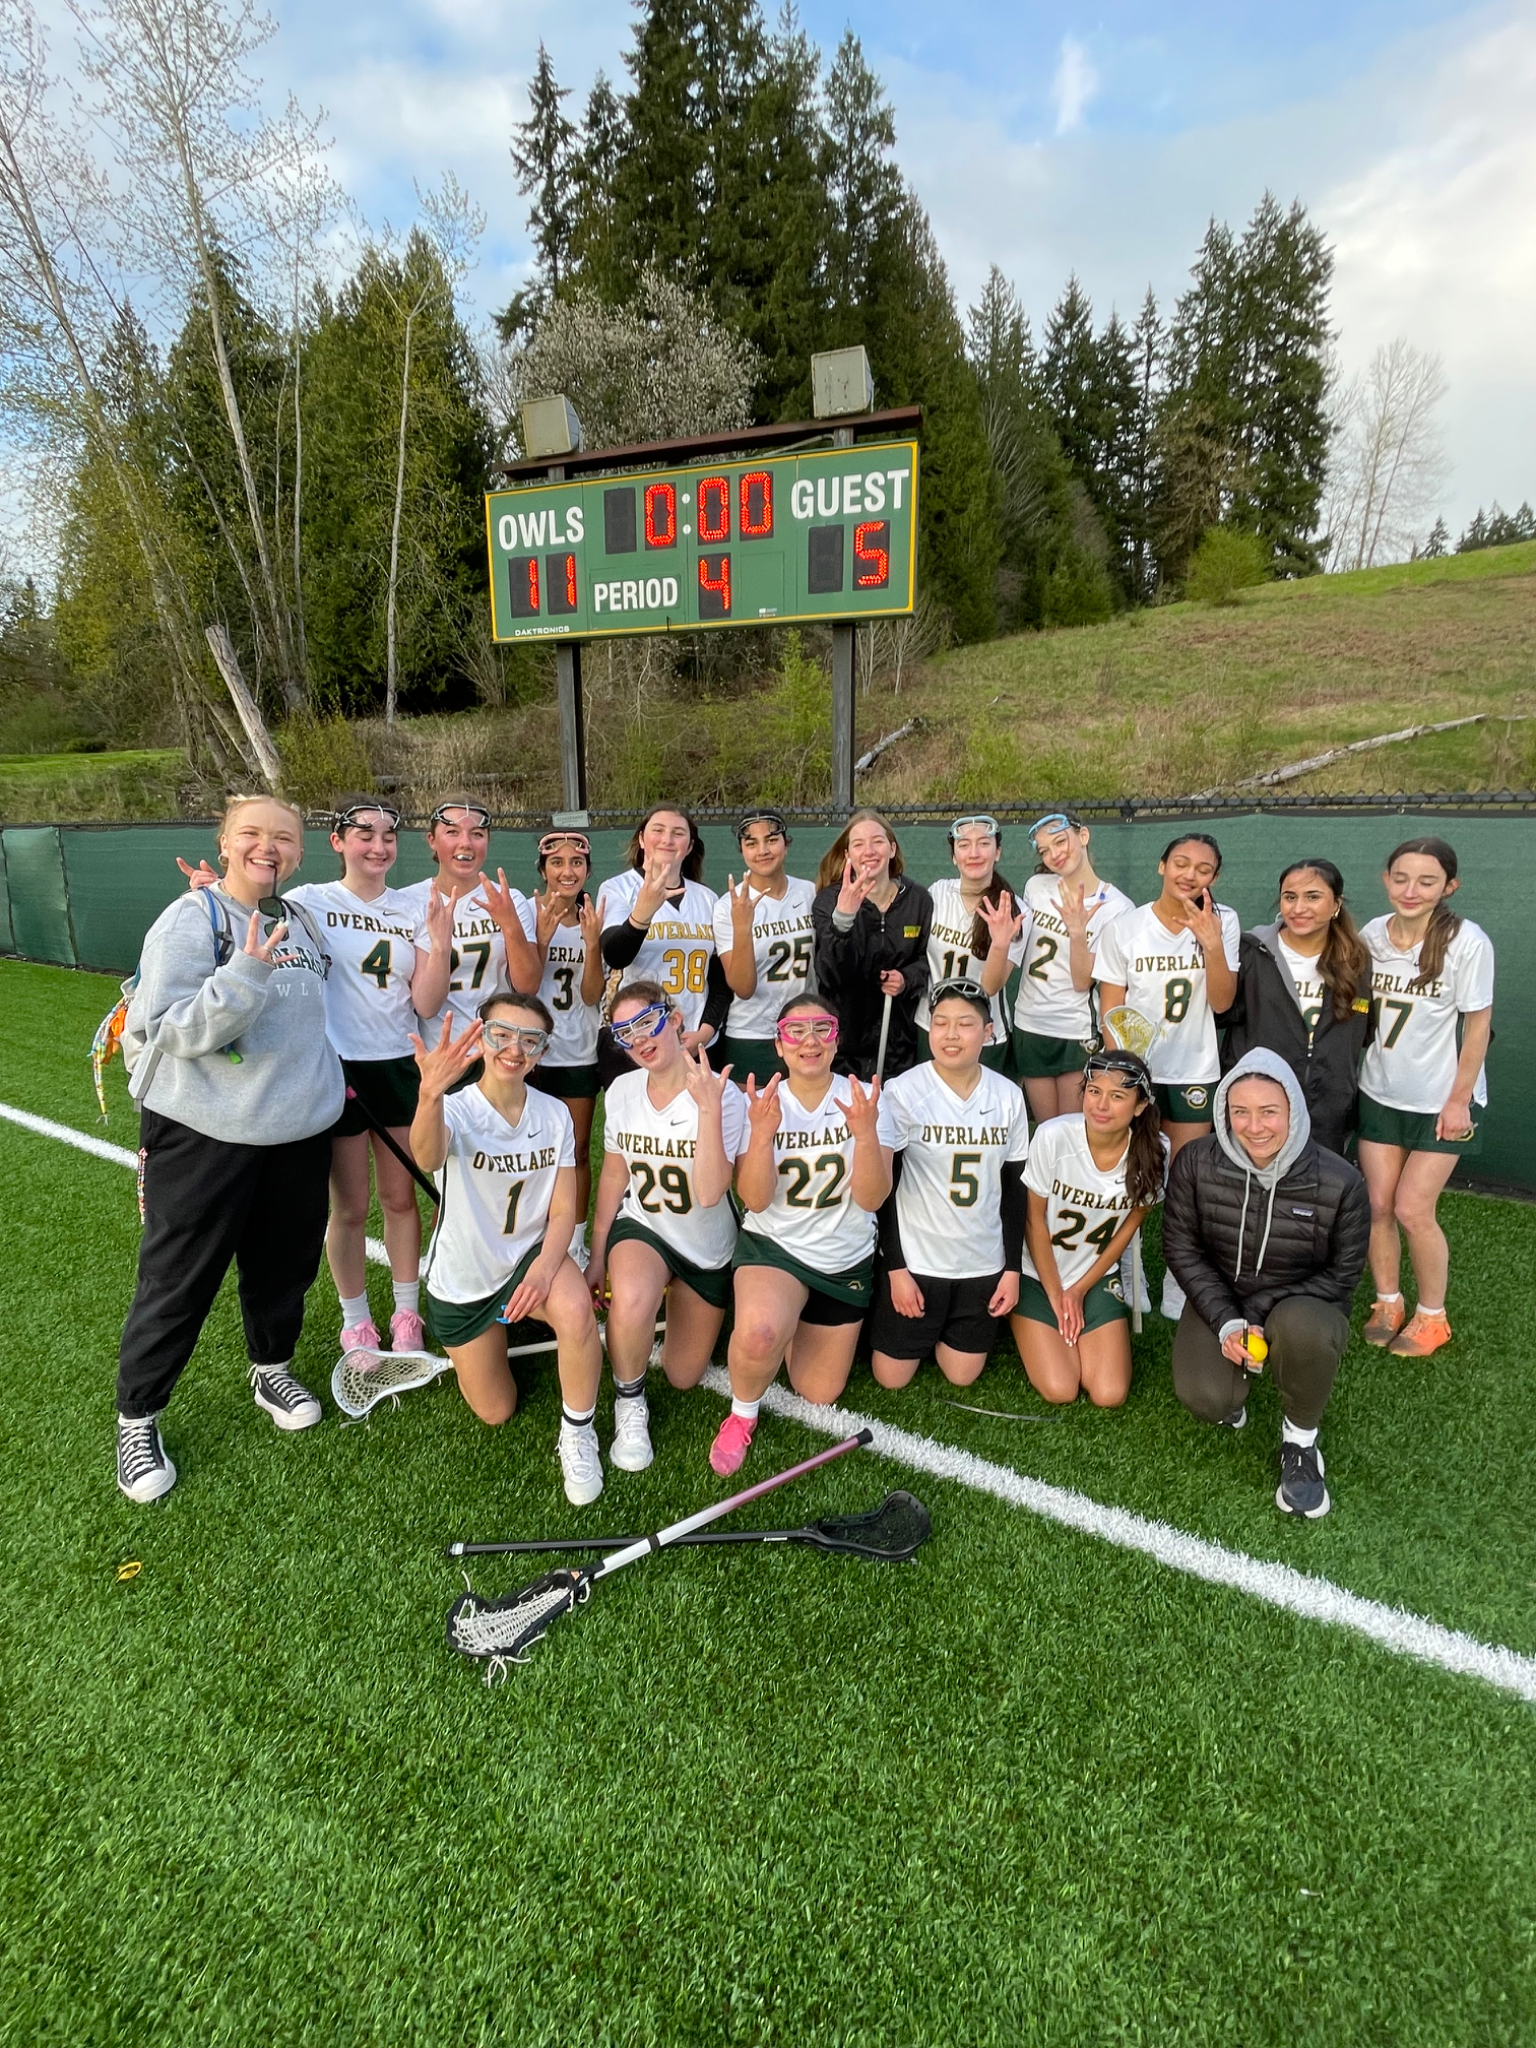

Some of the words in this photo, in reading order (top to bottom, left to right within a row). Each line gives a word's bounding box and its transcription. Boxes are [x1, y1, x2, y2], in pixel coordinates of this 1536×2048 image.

[791, 468, 910, 519] GUEST
[498, 506, 584, 551] OWLS
[855, 520, 889, 586] 5
[529, 554, 576, 610] 11
[594, 577, 678, 613] PERIOD
[699, 557, 731, 611] 4
[514, 625, 570, 637] DAKTRONICS
[452, 918, 503, 939] RLAKE
[645, 921, 715, 941] OVERLAK
[930, 922, 976, 950] OVERL
[361, 939, 392, 990] 4
[449, 941, 492, 992] 27
[549, 947, 585, 963] ERLA
[662, 948, 708, 995] 38
[767, 935, 814, 983] 25
[942, 949, 970, 979] 11
[1028, 935, 1059, 982] 2
[1135, 952, 1206, 973] OVERLA
[552, 967, 575, 1012] 3
[1164, 977, 1193, 1024] 8
[1371, 972, 1444, 999] ERLAKE
[773, 1121, 852, 1151] VERLAK
[922, 1124, 1009, 1146] OVERLAKE
[473, 1147, 555, 1173] OVERLAKE
[777, 1152, 845, 1210] 22
[949, 1151, 982, 1209] 5
[502, 1179, 526, 1235] 1
[630, 1160, 693, 1215] 29
[1051, 1178, 1136, 1211] OVERLAK
[1050, 1208, 1121, 1255] 24
